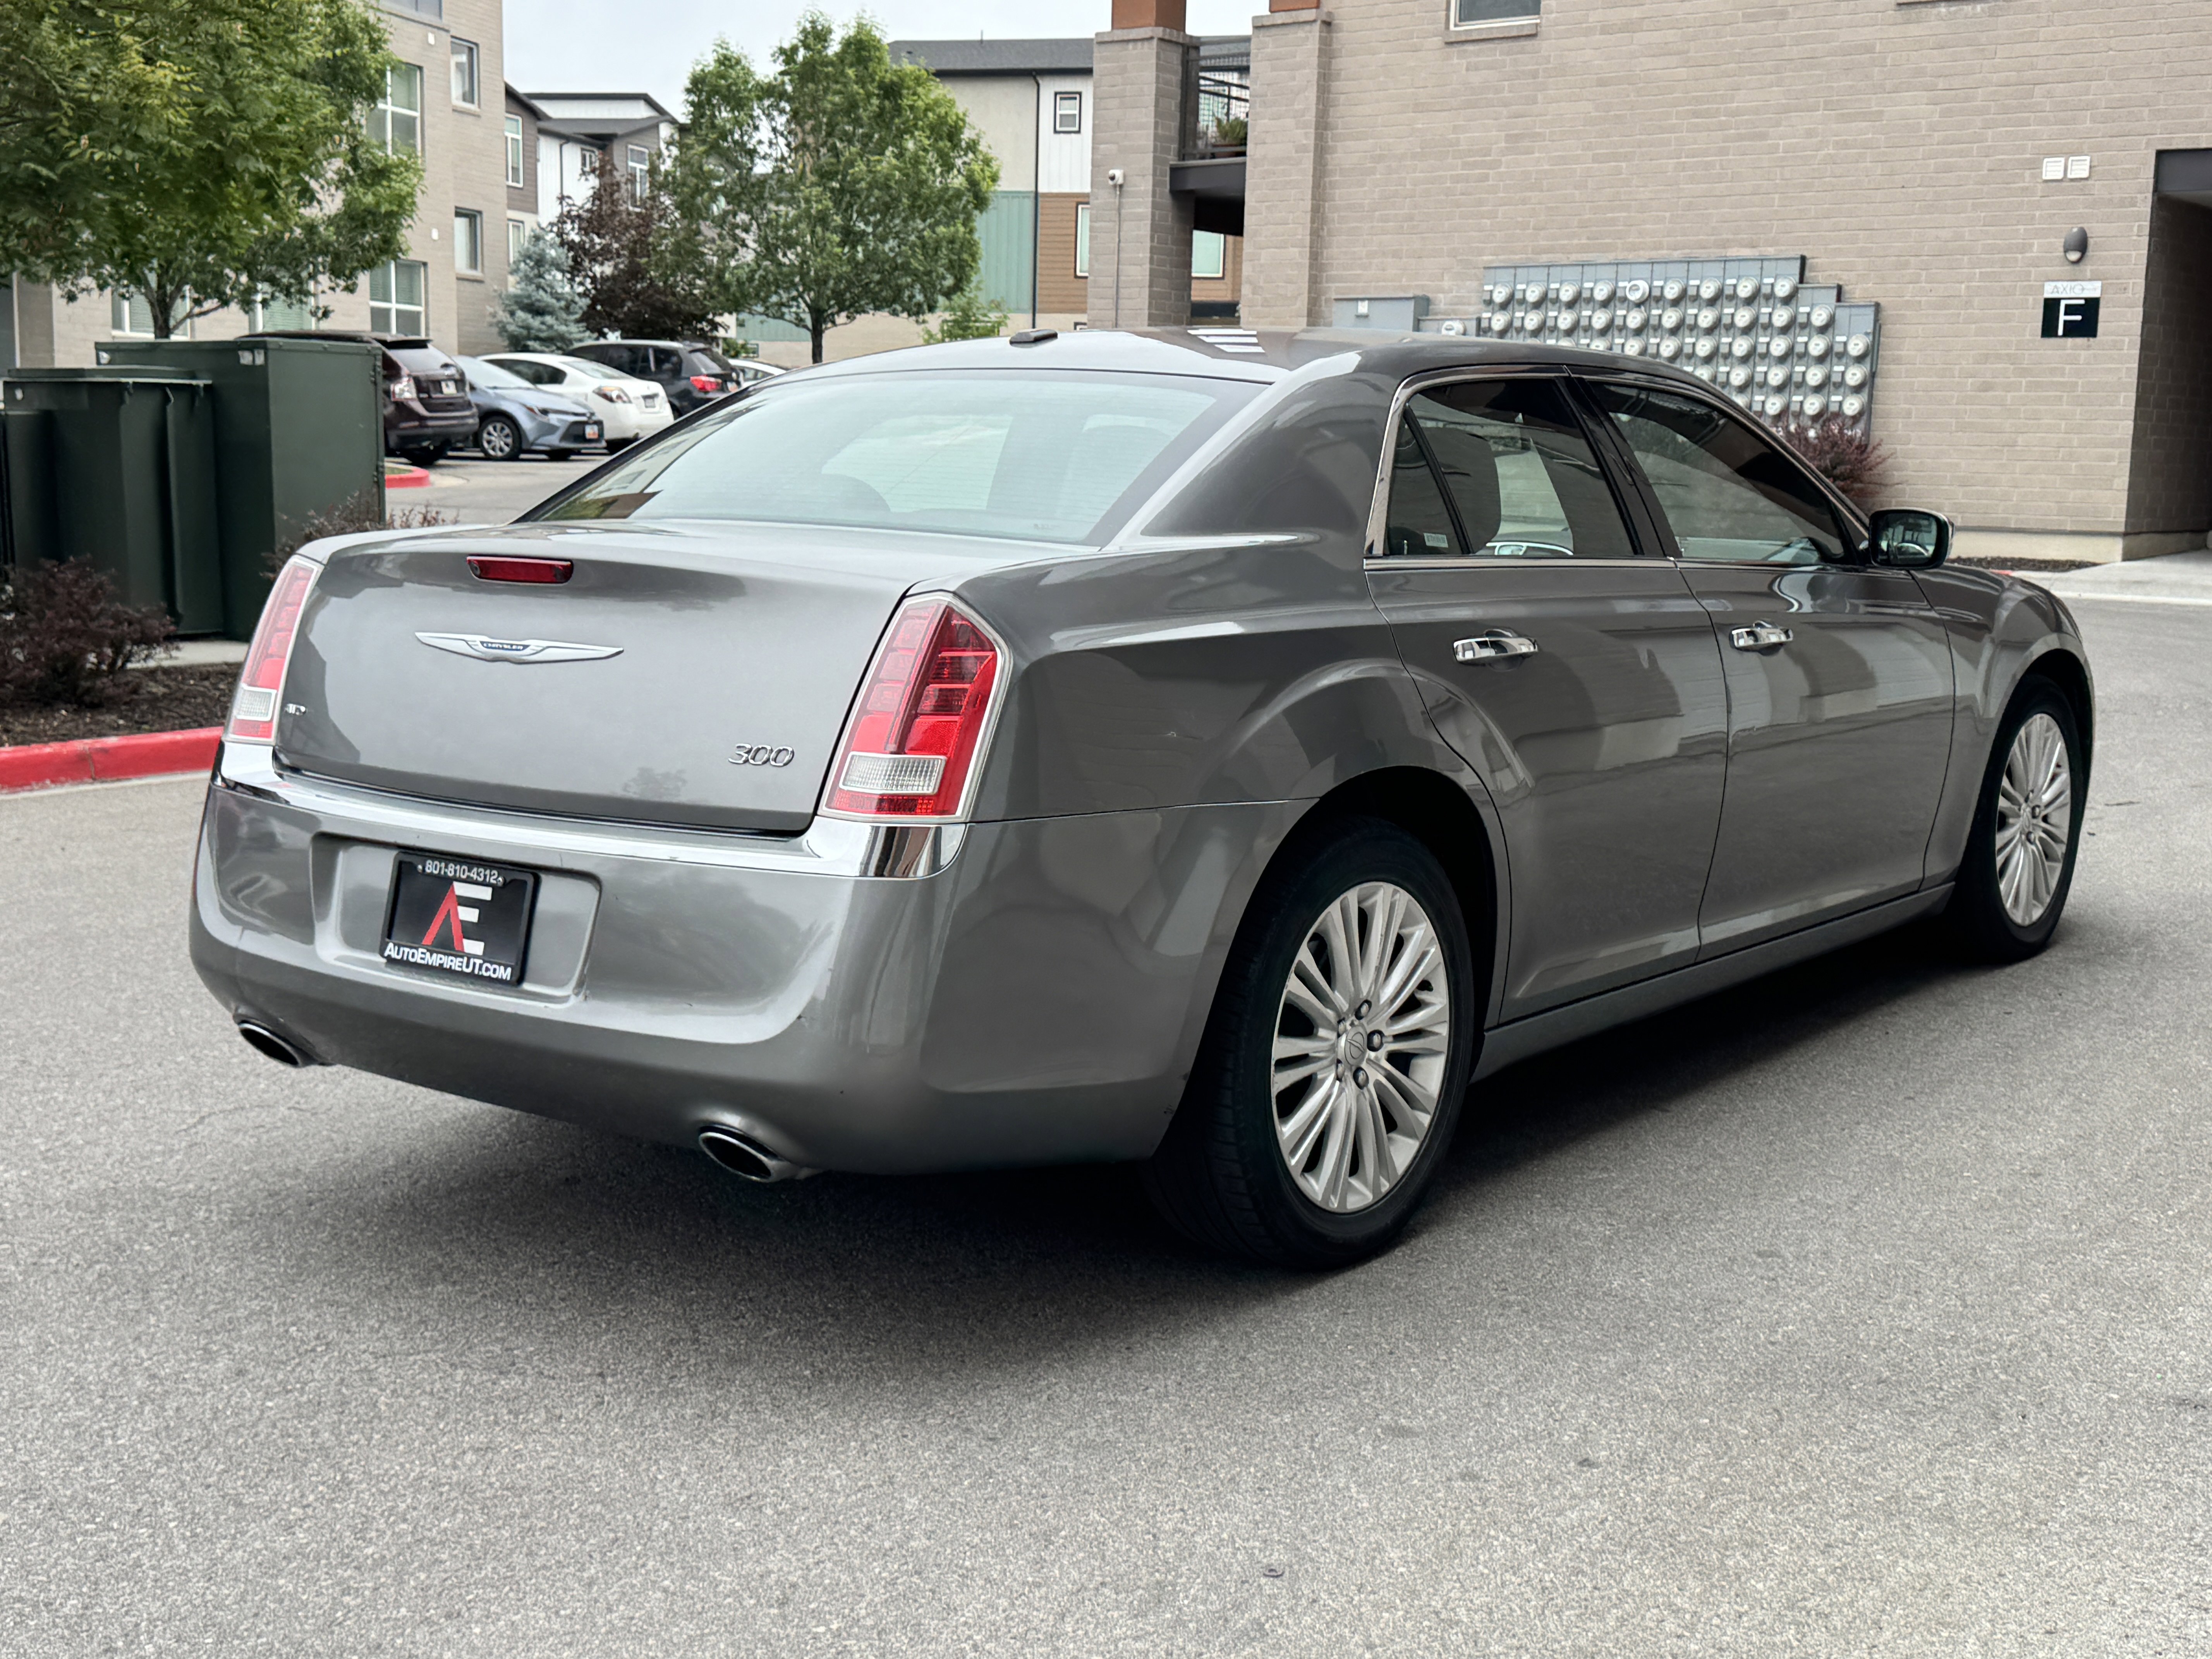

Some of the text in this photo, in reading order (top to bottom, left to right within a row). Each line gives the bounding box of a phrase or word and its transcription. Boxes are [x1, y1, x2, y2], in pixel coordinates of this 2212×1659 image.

[2058, 299, 2085, 336] F
[728, 743, 794, 767] 300
[425, 860, 498, 883] 801-810-4312
